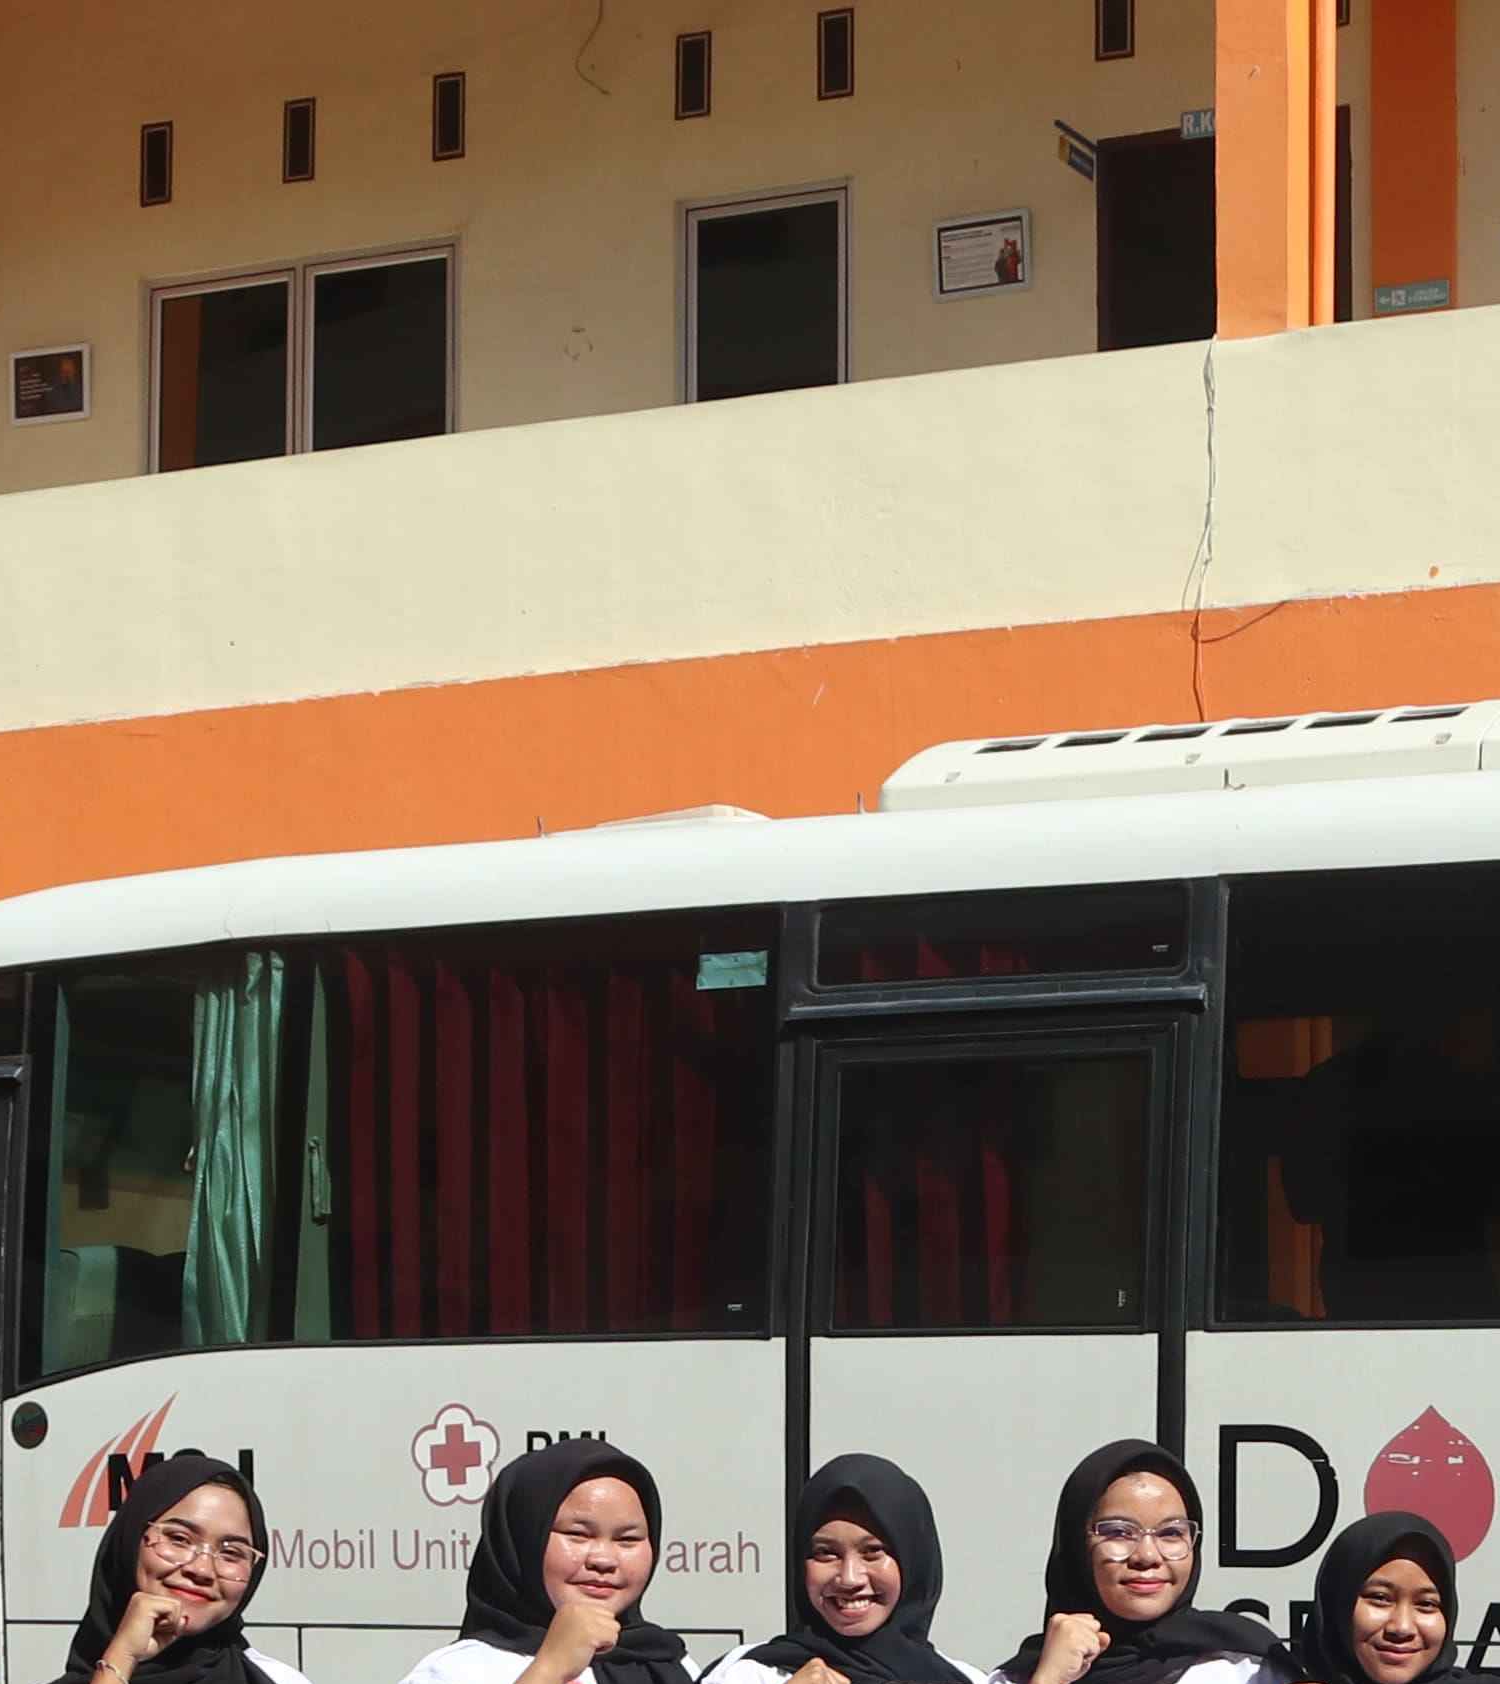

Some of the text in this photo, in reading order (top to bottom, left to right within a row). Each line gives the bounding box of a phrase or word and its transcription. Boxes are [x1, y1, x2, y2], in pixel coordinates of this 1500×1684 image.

[271, 1529, 761, 1573] Mobil Unit arah
